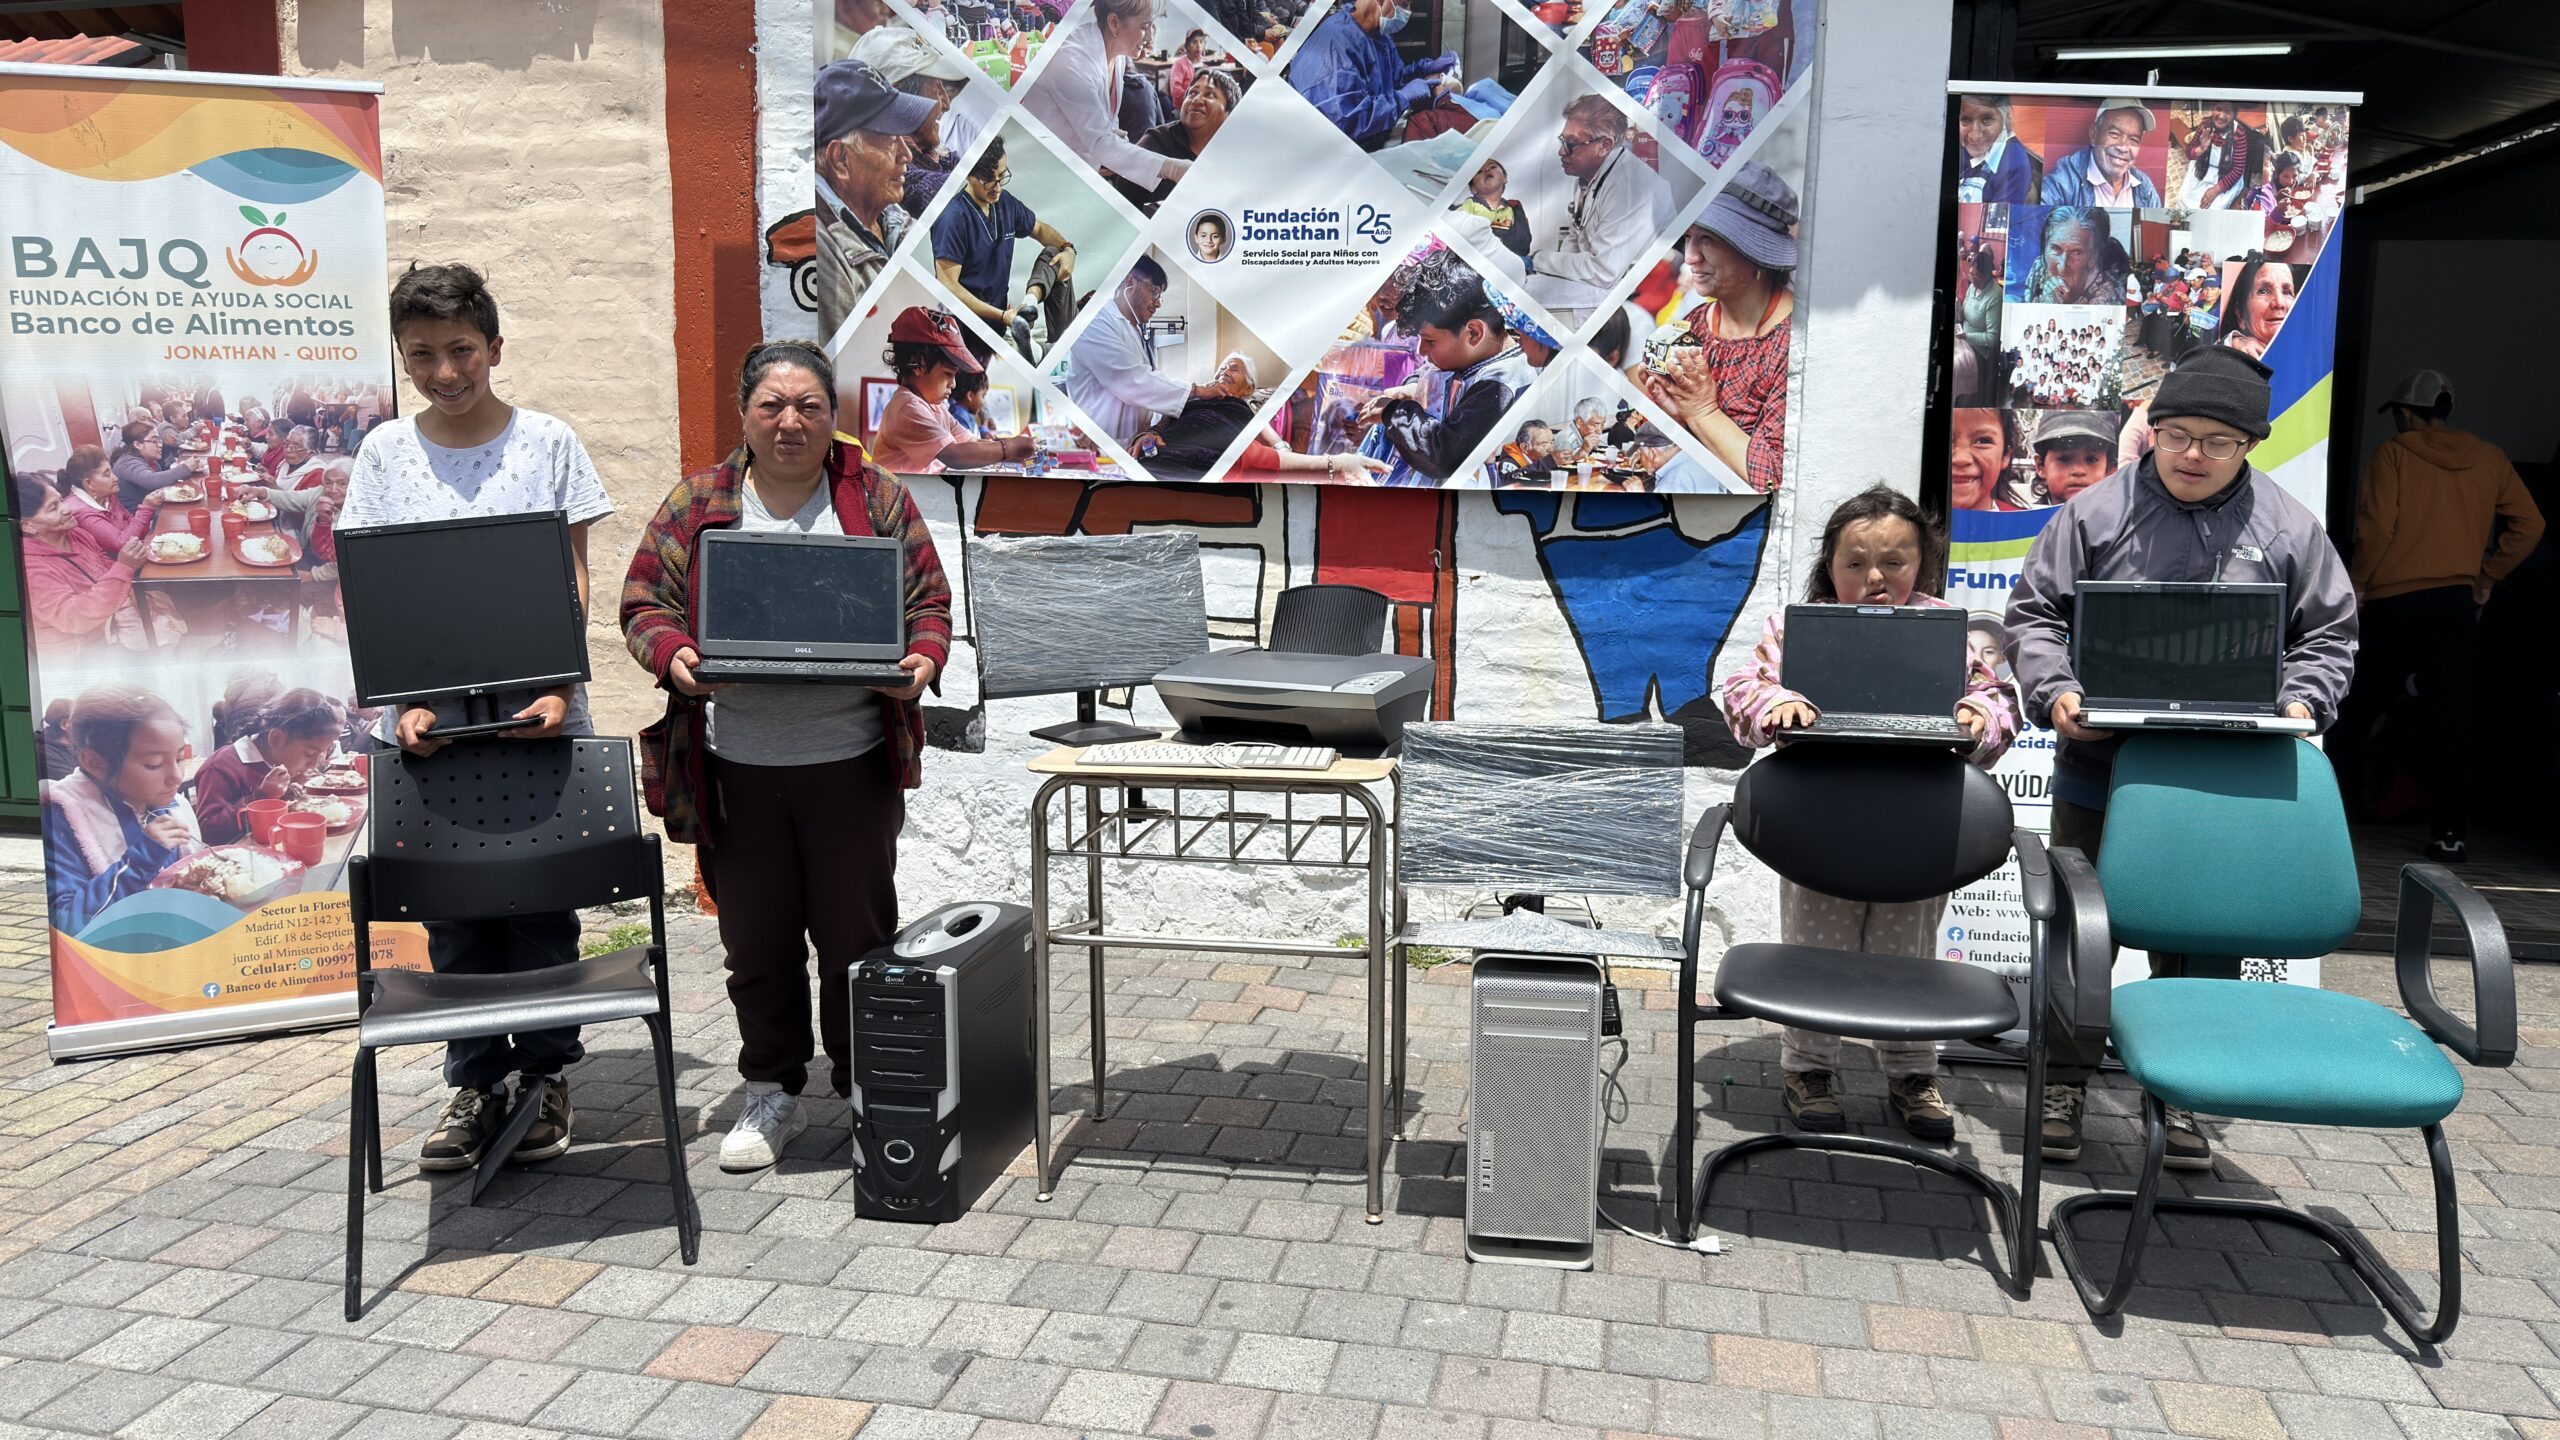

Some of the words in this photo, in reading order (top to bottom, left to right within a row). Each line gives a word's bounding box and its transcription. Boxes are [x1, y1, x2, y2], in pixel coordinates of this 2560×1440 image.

[1243, 207, 1339, 223] Fundación
[1357, 204, 1392, 244] 25
[1241, 225, 1340, 241] Jonathan
[12, 236, 212, 289] BAJQ
[1241, 258, 1304, 267] Discapacidades
[1305, 259, 1311, 267] y
[1312, 258, 1345, 266] Adultos
[1346, 258, 1380, 267] Mayores
[1243, 249, 1279, 258] Servicio
[1281, 249, 1308, 258] Social
[1311, 251, 1331, 259] para
[1333, 249, 1359, 258] Niños
[9, 286, 147, 307] FUNDACIÓN
[156, 291, 184, 307] DE
[191, 292, 268, 308] AYUDA
[274, 293, 353, 310] SOCIAL
[10, 312, 121, 335] Banco
[132, 312, 175, 335] de
[185, 311, 355, 337] Alimentos
[163, 345, 276, 361] JONATHAN
[297, 346, 358, 361] QUITO
[1951, 889, 2001, 902] Email:
[261, 906, 297, 917] Sector
[300, 904, 310, 913] la
[313, 899, 351, 912] Florest
[1951, 904, 1990, 917] Web:
[1996, 909, 2029, 919] www
[245, 919, 284, 933] Madrid
[287, 915, 332, 929] N12-142
[335, 917, 342, 926] y
[255, 935, 279, 947] Edif.
[285, 932, 297, 943] 18
[300, 929, 312, 941] de
[1968, 929, 2030, 943] fundacio
[232, 950, 261, 965] junto
[263, 949, 273, 960] al
[276, 943, 330, 958] Ministerio
[332, 941, 344, 952] de
[1969, 950, 2031, 963] fundacio
[240, 961, 298, 977] Celular:
[317, 949, 394, 967] 09997078
[226, 982, 261, 994] Banco
[264, 979, 278, 990] de
[280, 973, 335, 987] Alimentos
